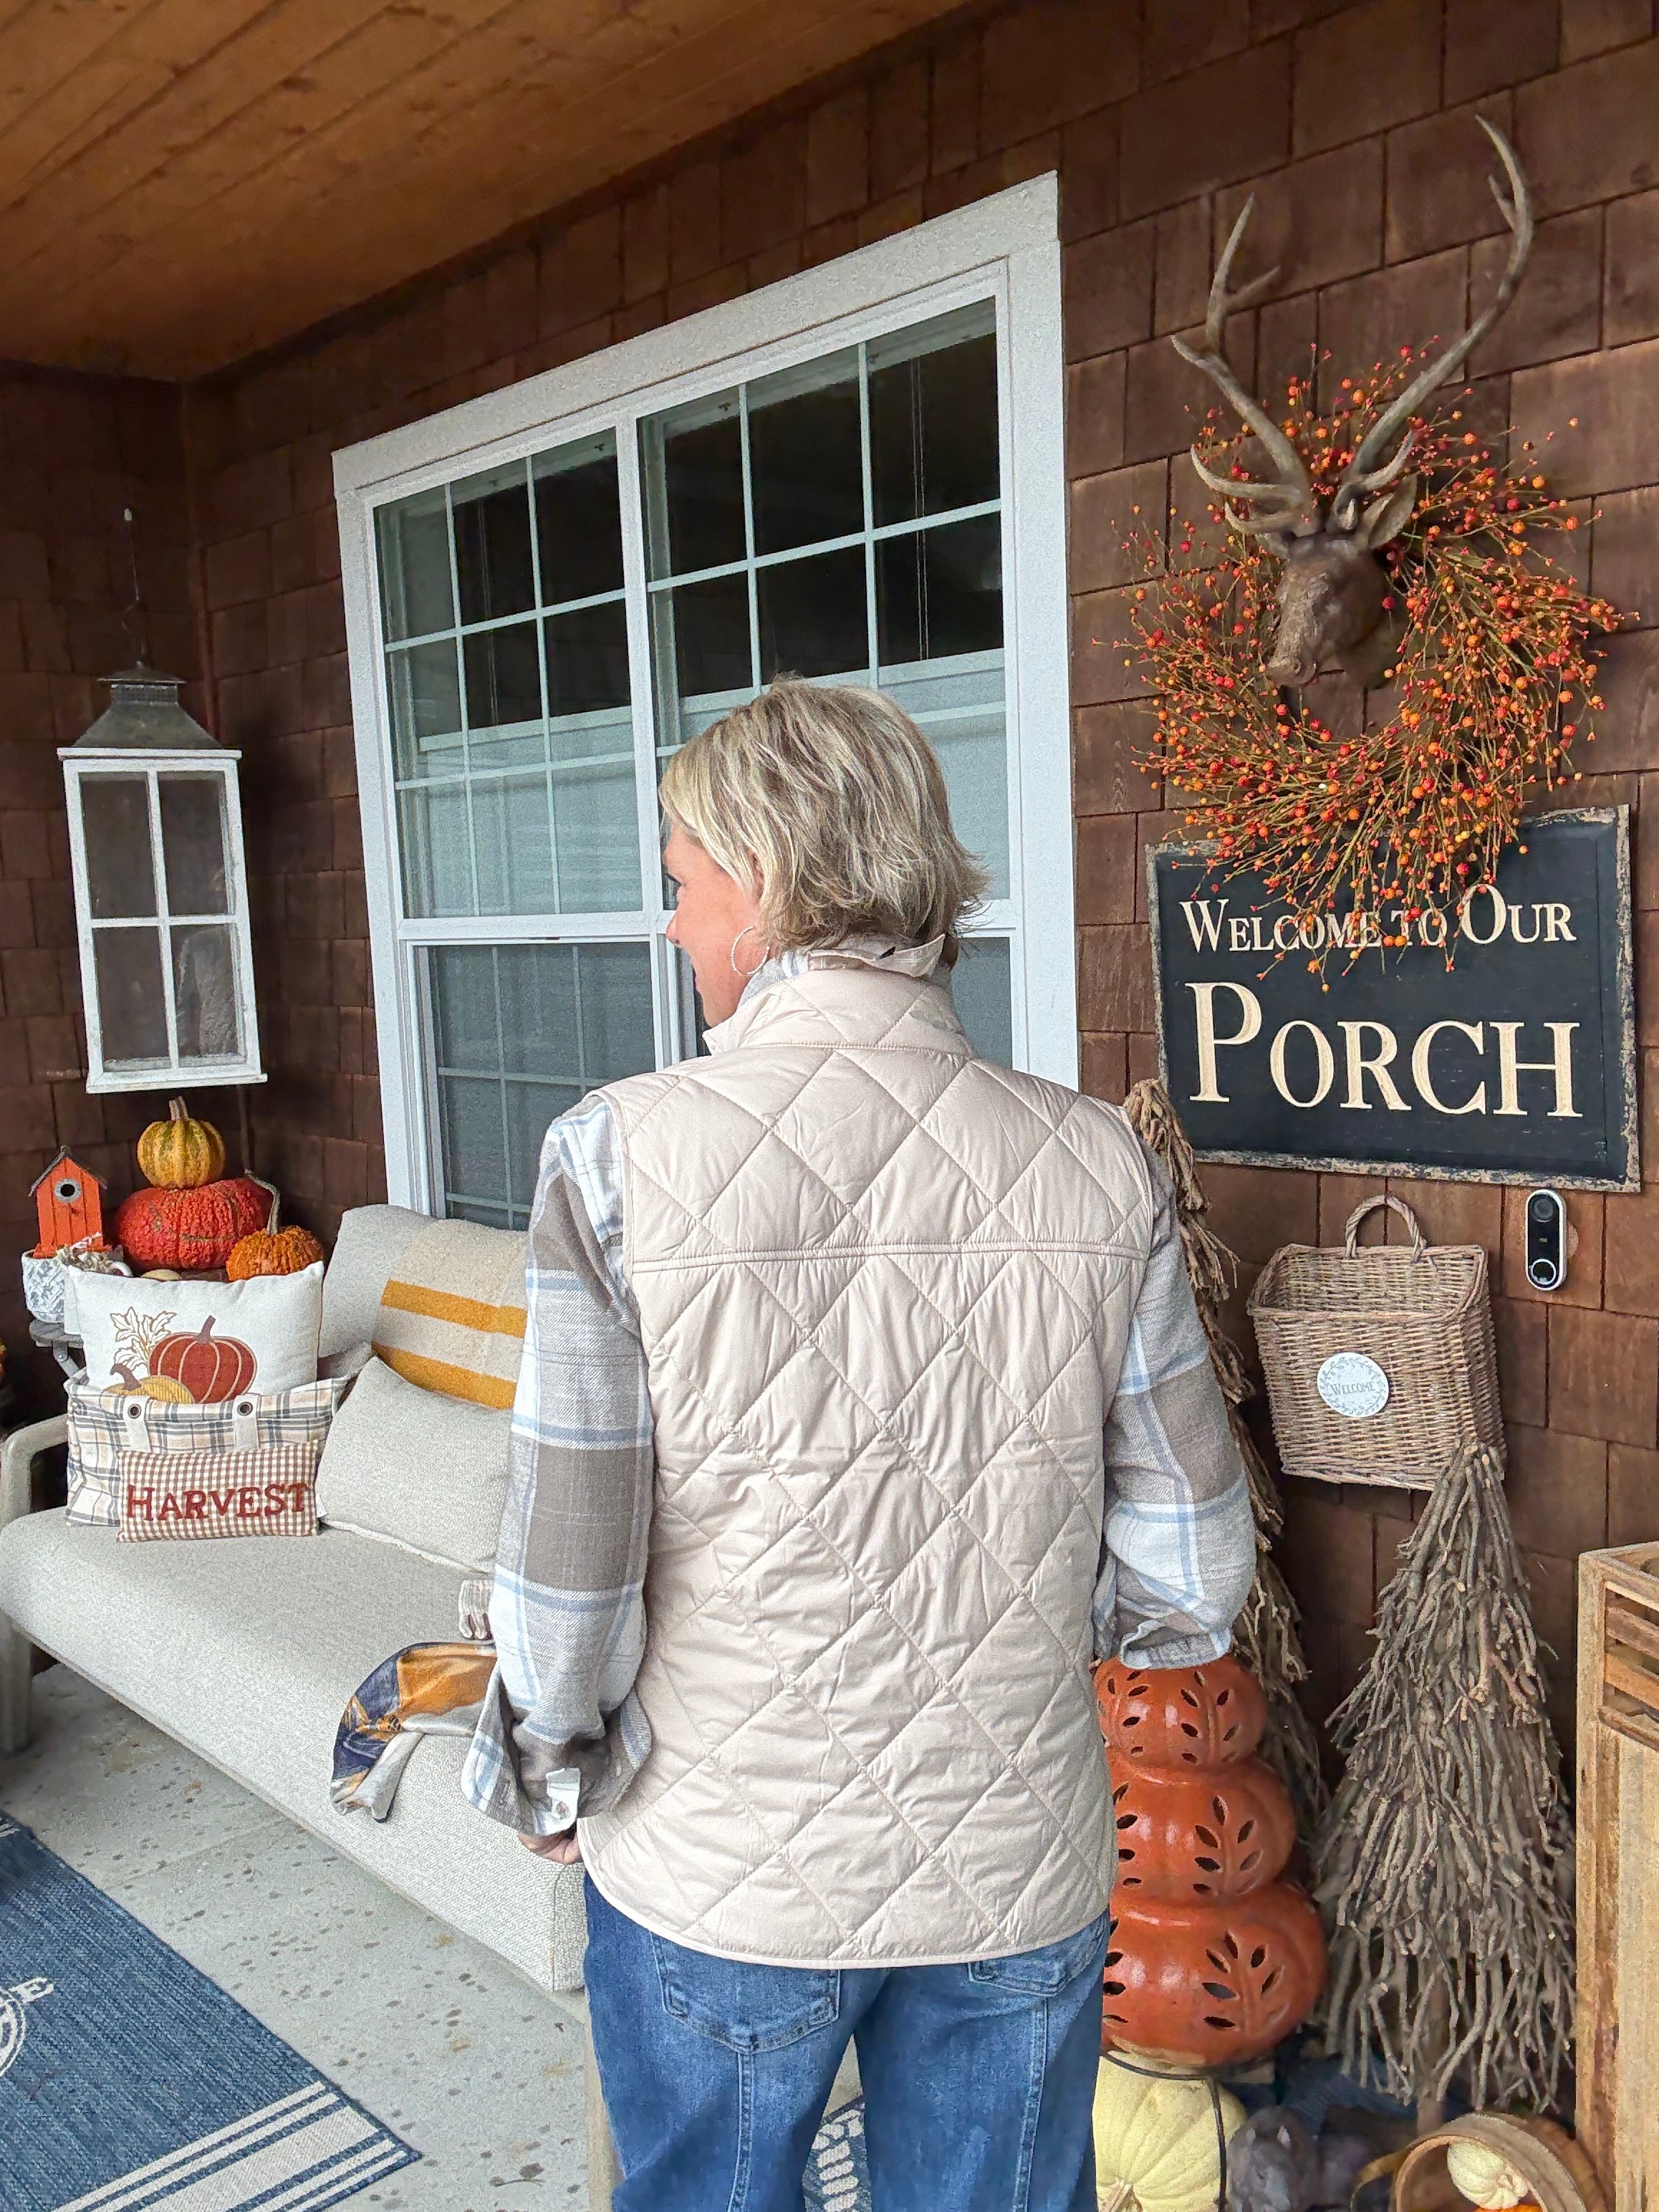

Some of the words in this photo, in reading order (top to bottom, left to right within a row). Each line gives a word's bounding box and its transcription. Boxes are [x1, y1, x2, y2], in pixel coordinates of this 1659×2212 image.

[1179, 898, 1382, 953] WELCOME
[1390, 908, 1448, 948] TO
[1461, 883, 1578, 946] OUR
[1185, 981, 1583, 1118] PORCH
[1330, 1381, 1376, 1395] WELCOME
[126, 1483, 310, 1522] HARVEST
